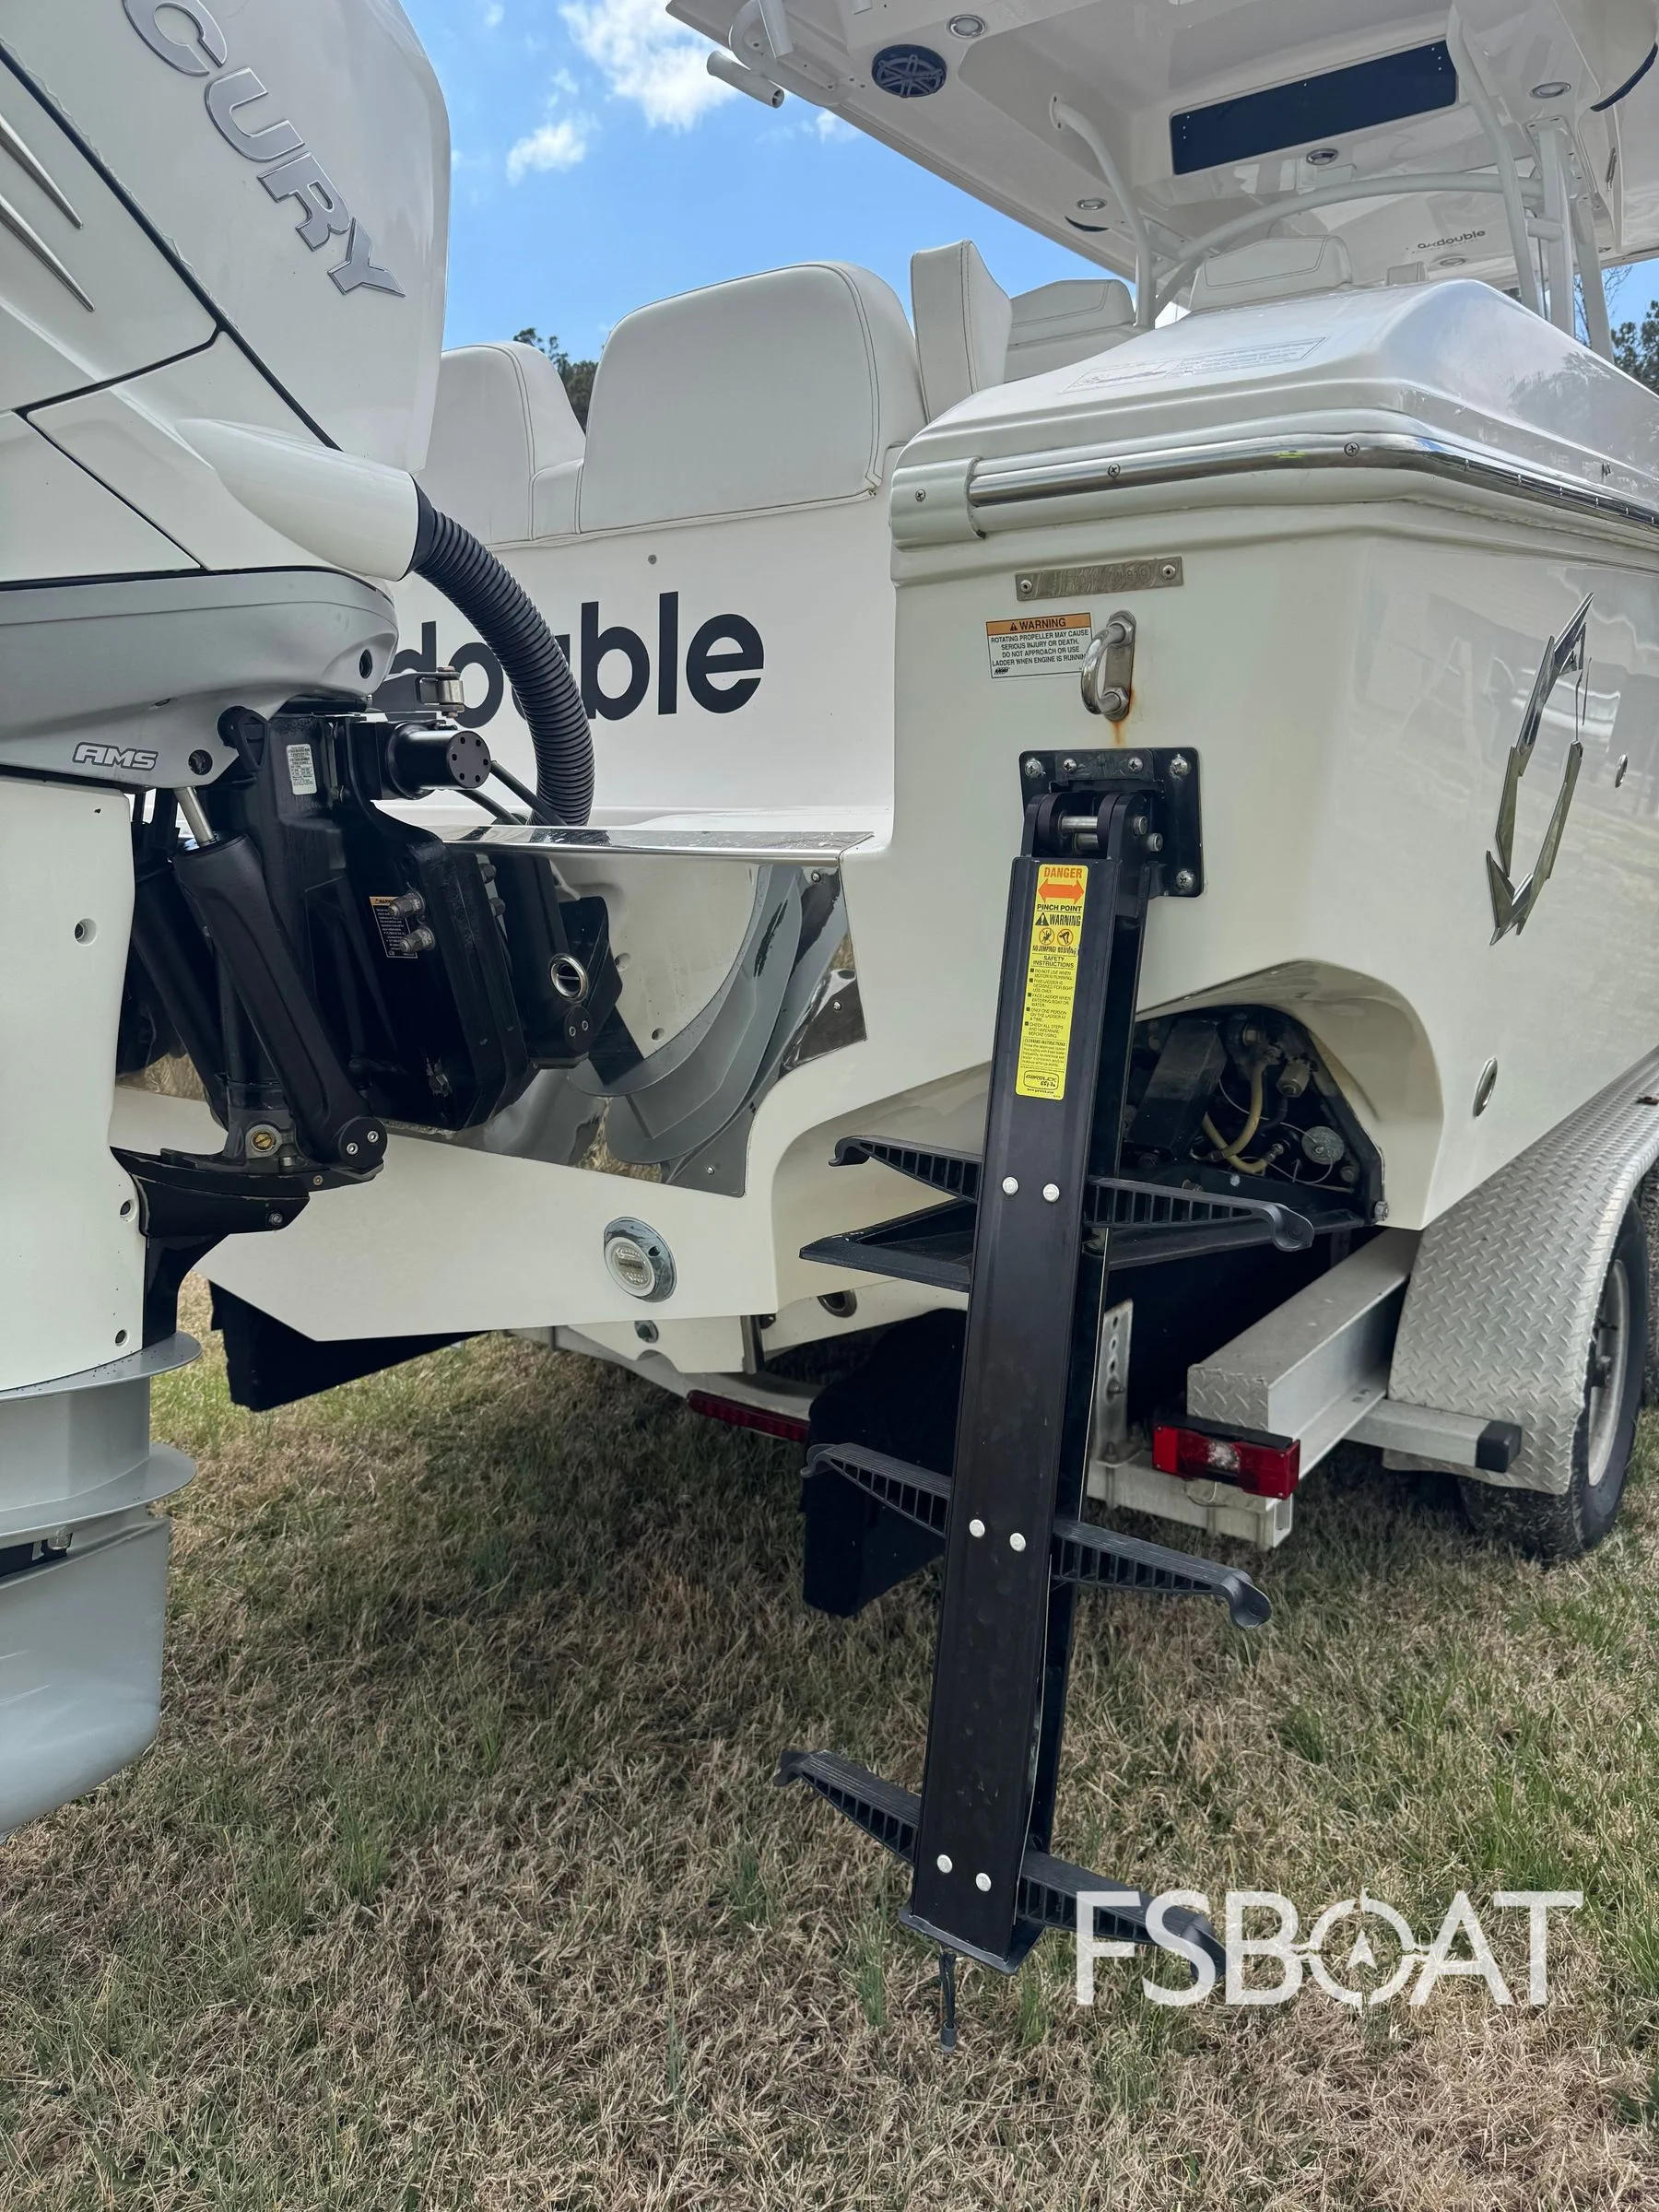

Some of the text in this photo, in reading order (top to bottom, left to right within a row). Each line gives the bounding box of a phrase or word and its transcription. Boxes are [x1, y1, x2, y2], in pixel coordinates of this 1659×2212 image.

[122, 0, 406, 297] CURY
[1019, 618, 1065, 630] WARNING
[1024, 647, 1056, 656] APPROACH
[390, 591, 765, 729] doble
[73, 741, 159, 771] AMS
[1043, 867, 1082, 878] DANGER
[1050, 914, 1081, 926] WARNING
